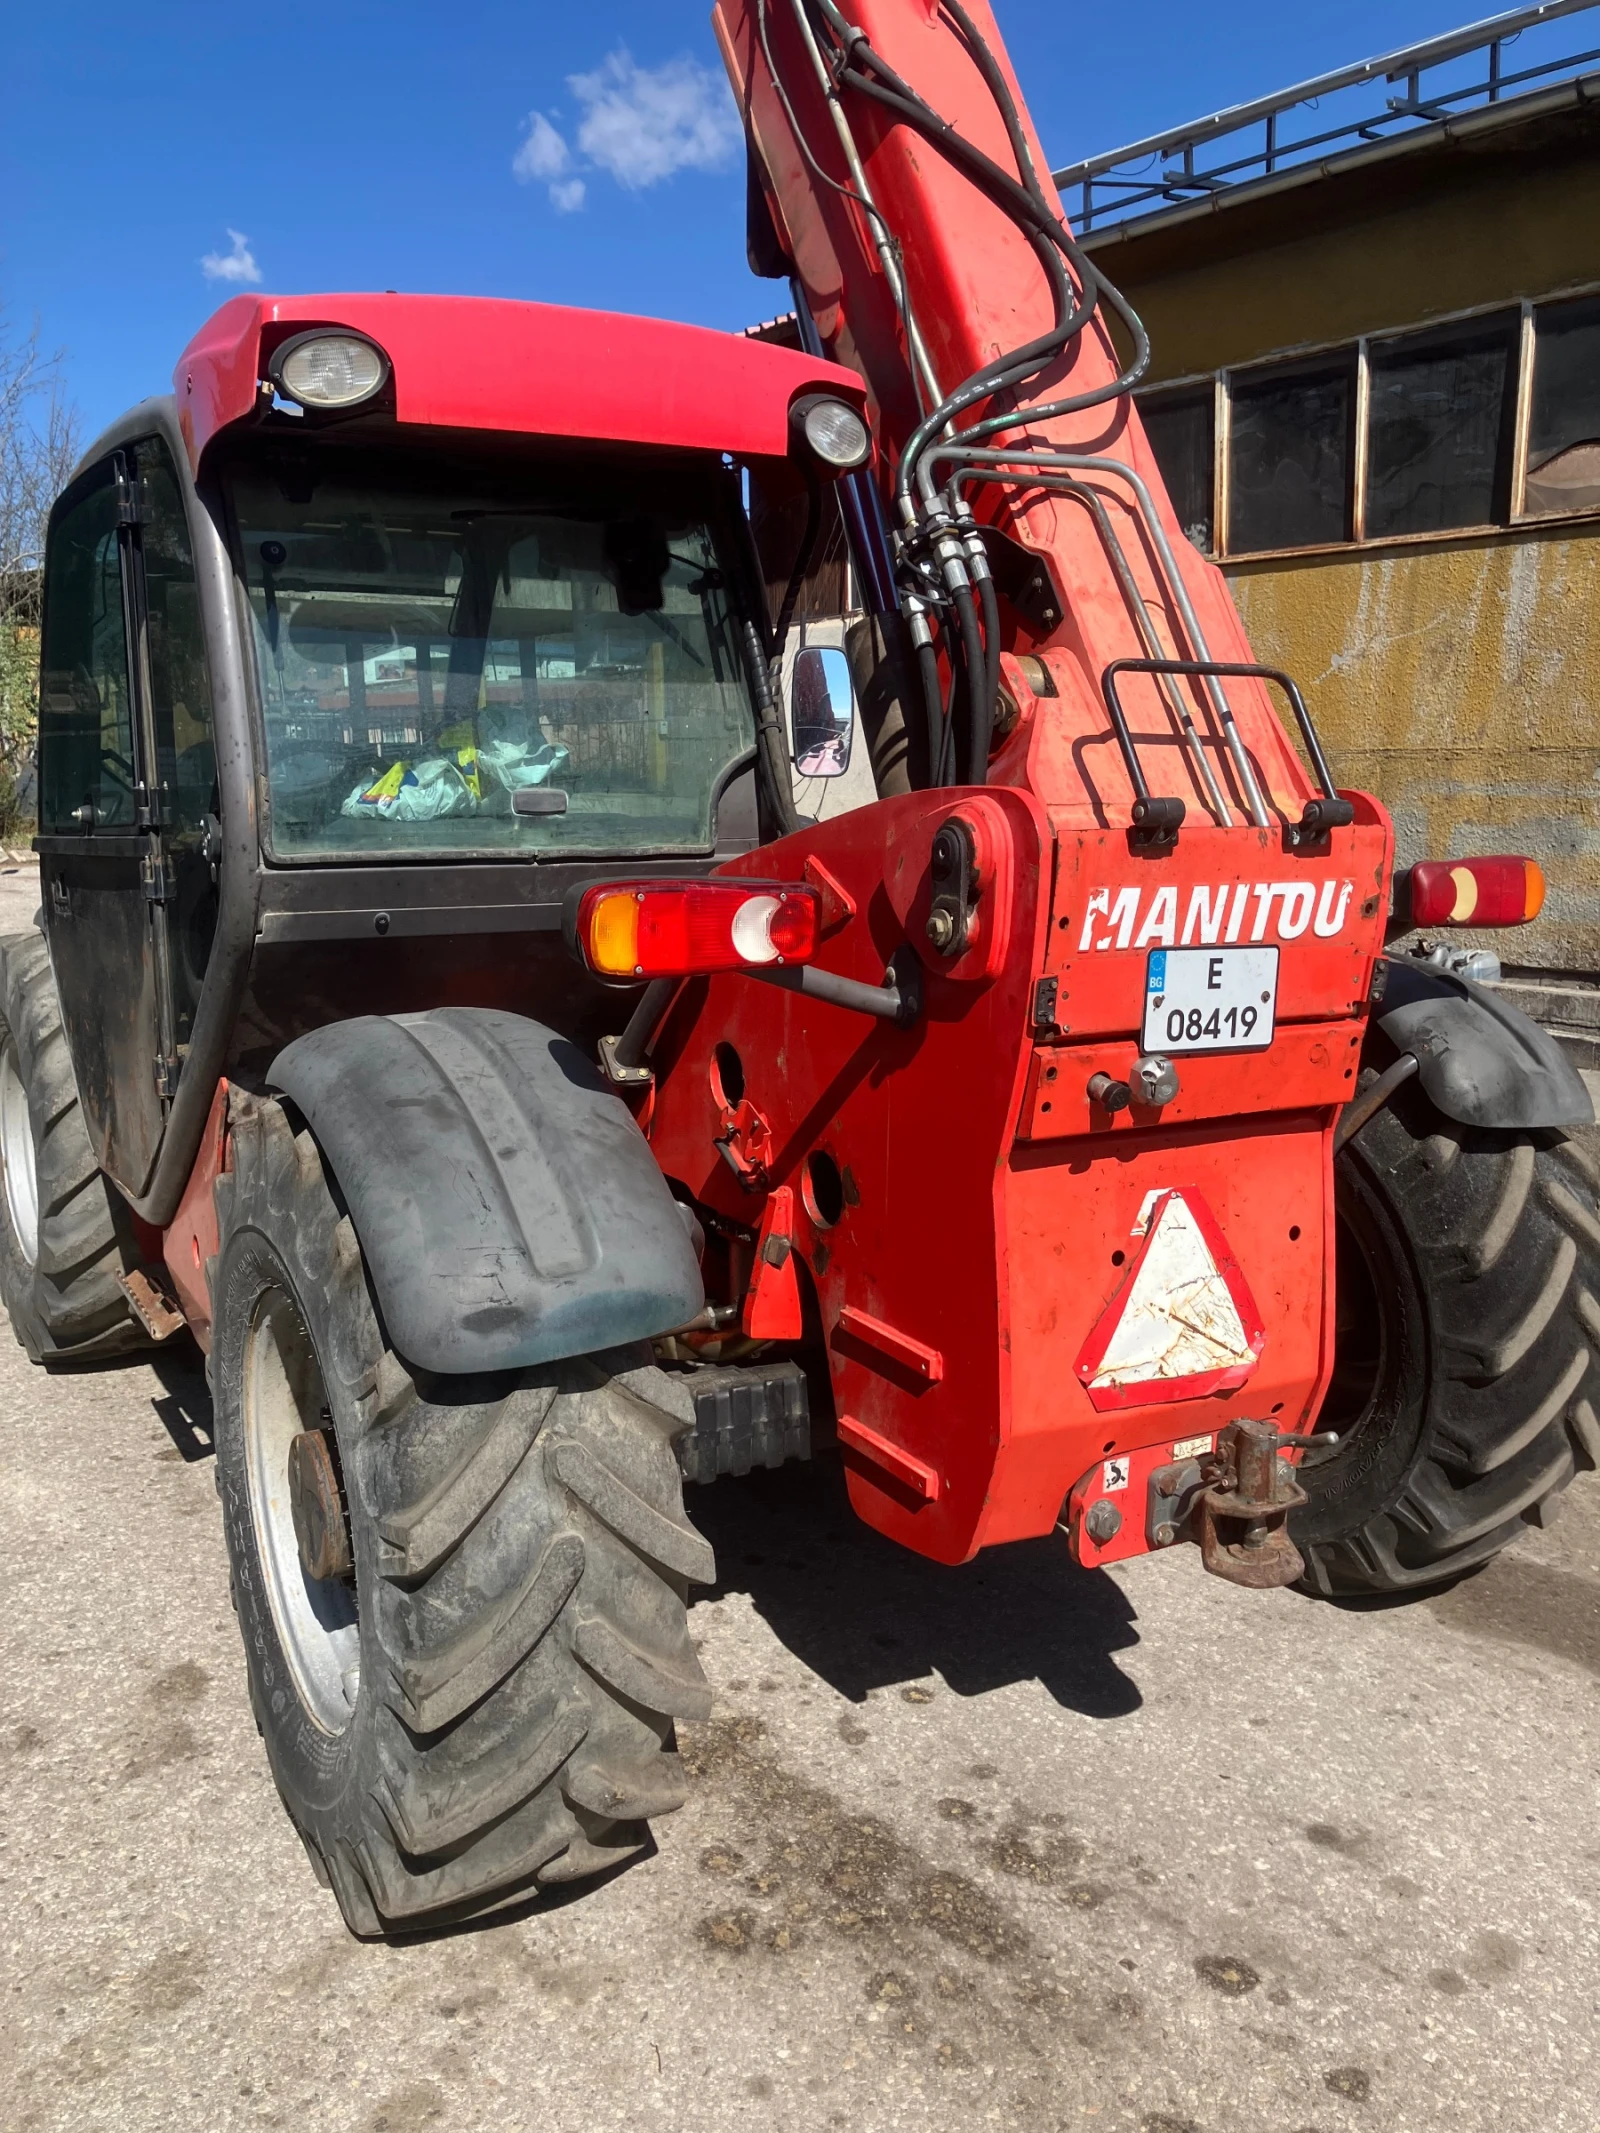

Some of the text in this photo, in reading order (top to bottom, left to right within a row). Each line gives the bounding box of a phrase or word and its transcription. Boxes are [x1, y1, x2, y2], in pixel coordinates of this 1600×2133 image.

[1078, 878, 1354, 951] MANITOU
[1149, 976, 1163, 989] BG
[1207, 958, 1223, 989] E
[1166, 1006, 1258, 1042] 08419
